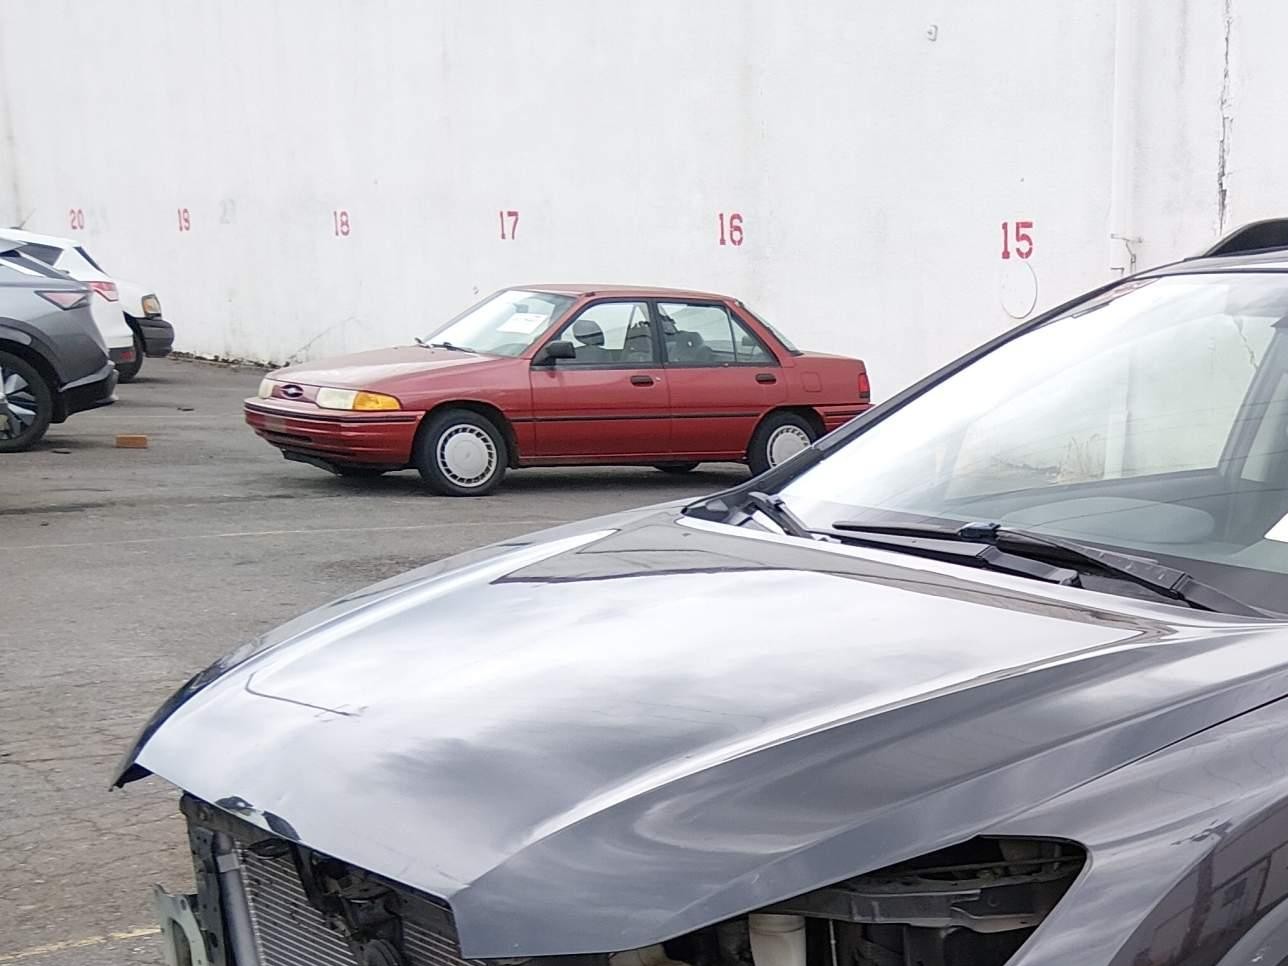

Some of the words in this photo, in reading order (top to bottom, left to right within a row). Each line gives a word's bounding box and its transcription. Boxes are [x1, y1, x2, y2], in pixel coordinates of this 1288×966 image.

[69, 208, 85, 230] 20
[177, 208, 191, 232] 19
[333, 210, 351, 237] 18
[499, 210, 520, 240] 17
[718, 212, 744, 247] 16
[1001, 220, 1034, 260] 15
